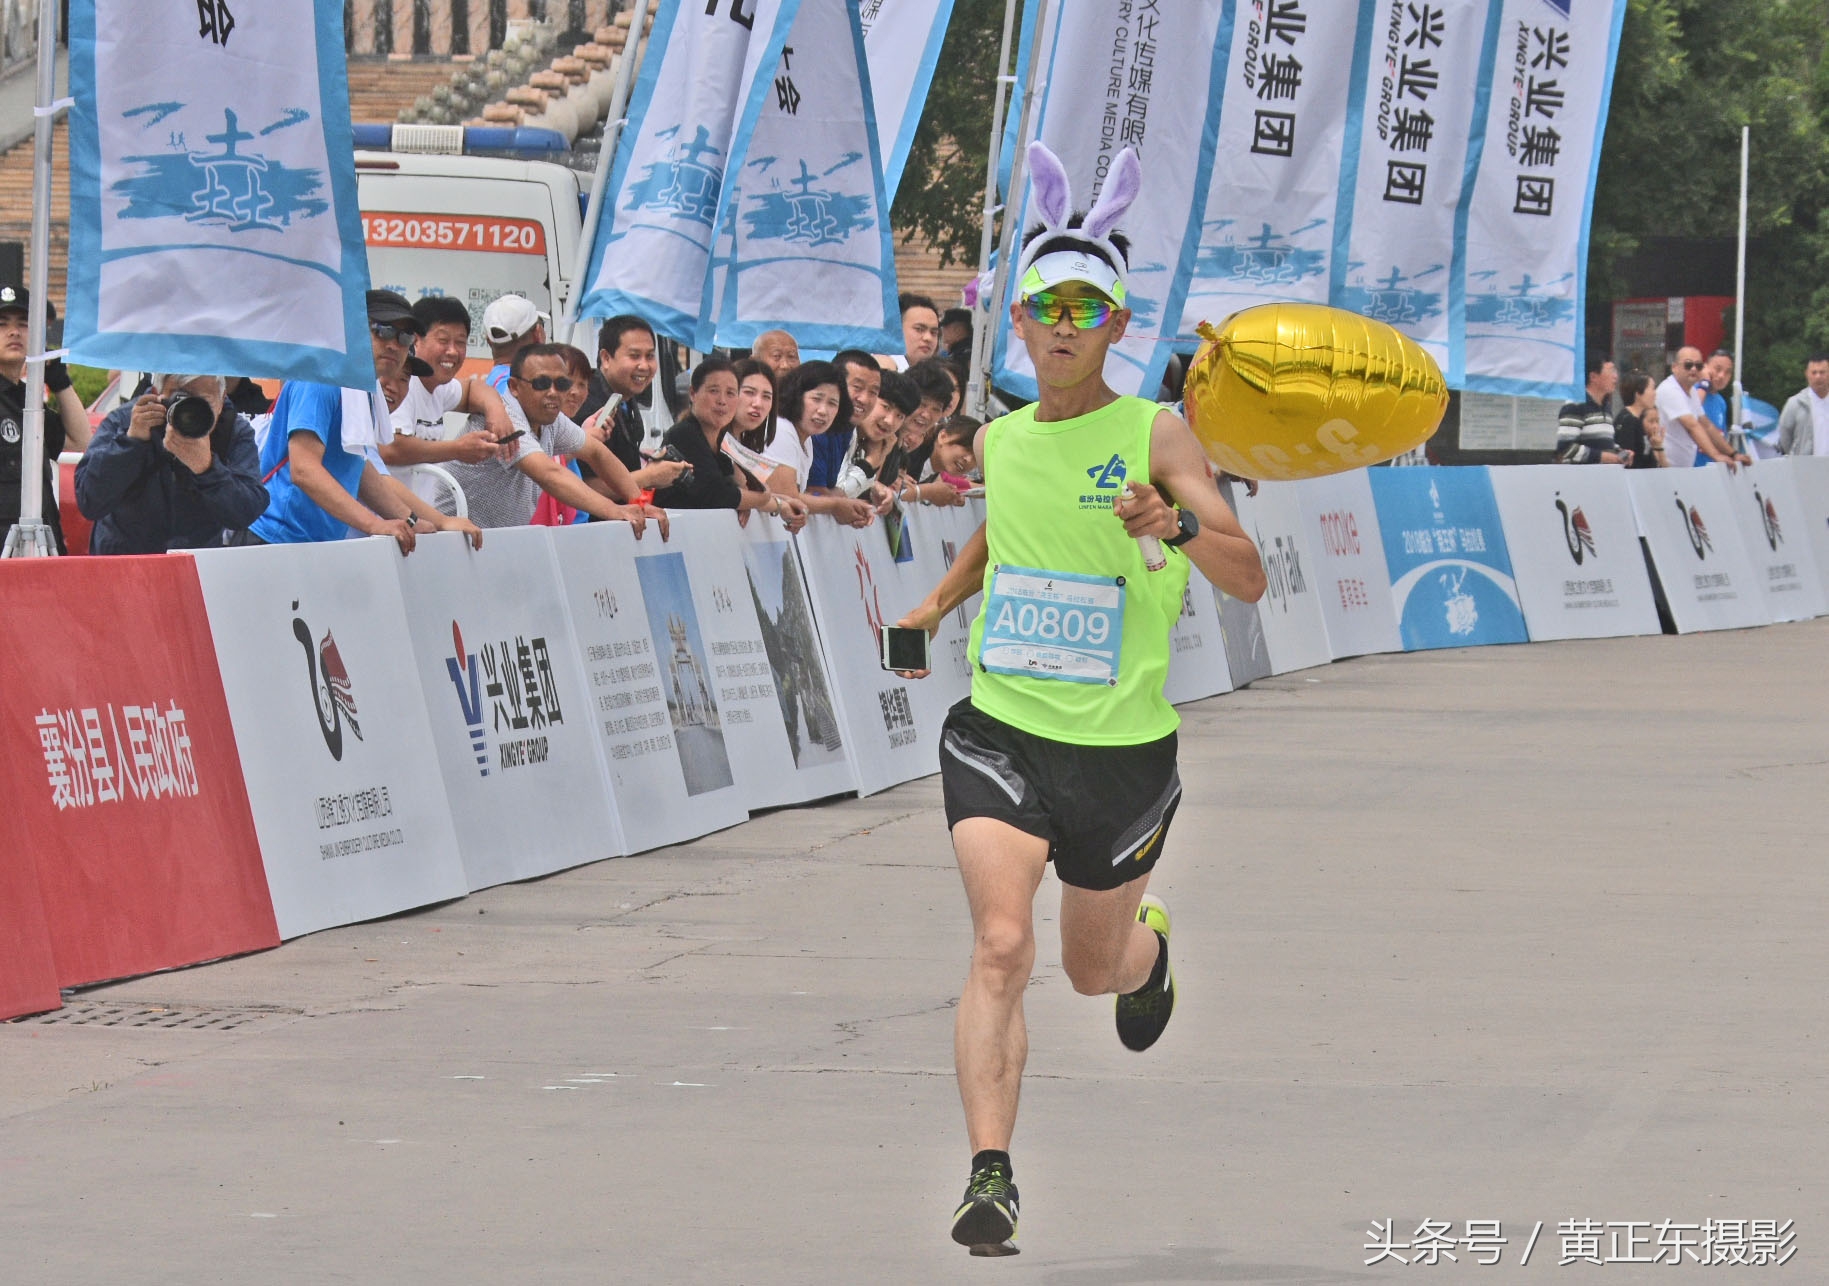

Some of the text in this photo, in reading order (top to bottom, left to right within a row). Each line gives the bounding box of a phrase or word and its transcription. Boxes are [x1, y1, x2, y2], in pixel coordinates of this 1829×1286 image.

[1107, 27, 1129, 99] CULTURE
[1243, 20, 1261, 89] GROUP
[1100, 102, 1118, 151] MEDIA
[1376, 76, 1394, 141] GROUP
[1382, 2, 1446, 206] 兴业集团
[1506, 96, 1522, 157] GROUP
[1513, 27, 1570, 216] 兴业集团
[361, 217, 536, 249] 13203571120
[993, 600, 1110, 645] A0809
[480, 635, 564, 735] 兴业集团
[35, 698, 199, 811] 襄汾县人民政府
[526, 736, 548, 764] GROUP
